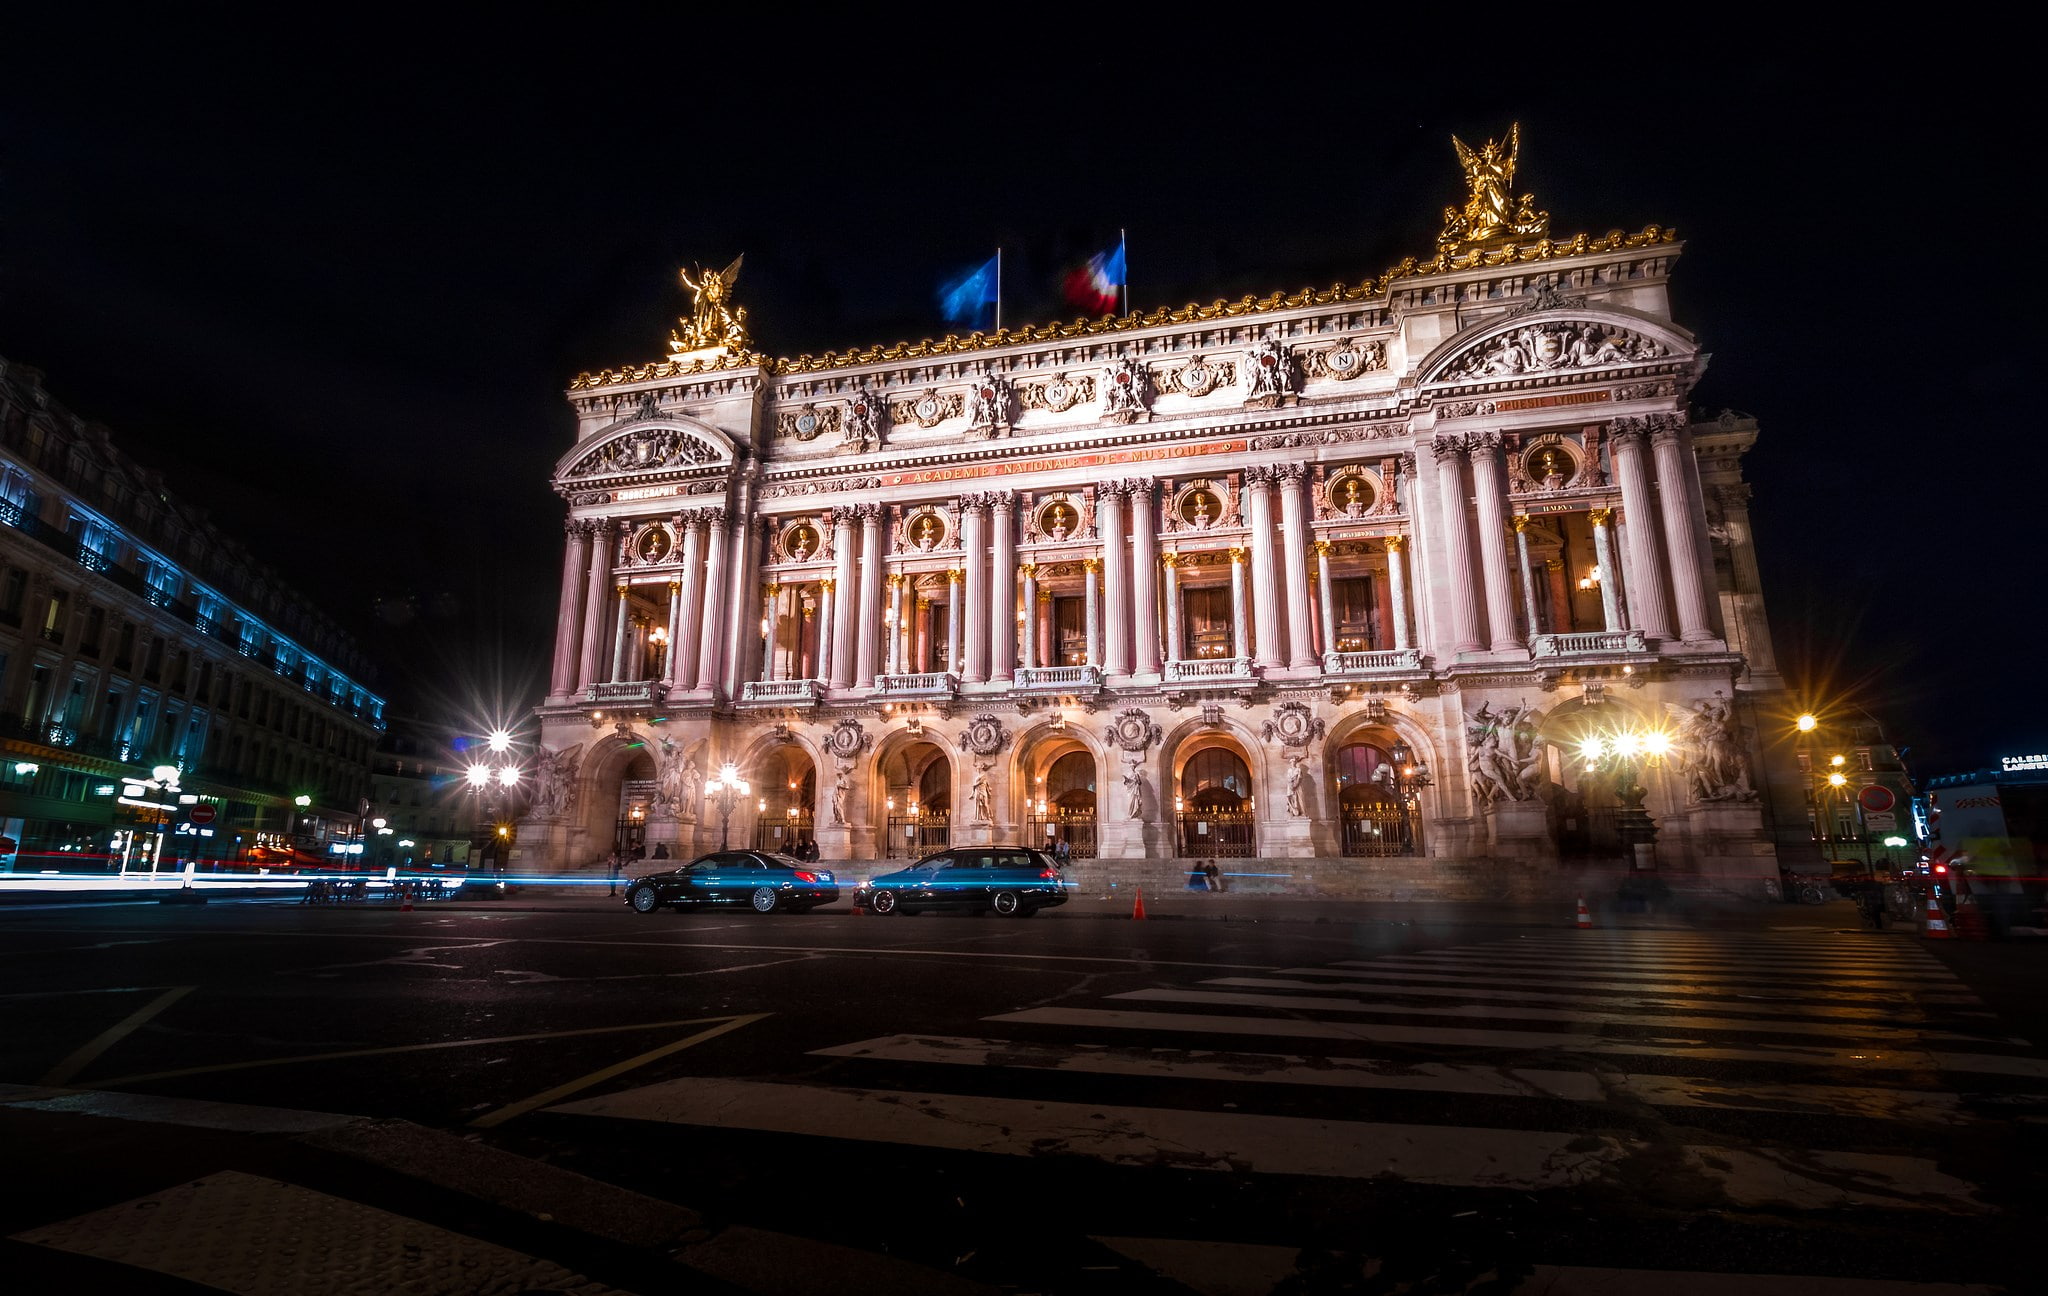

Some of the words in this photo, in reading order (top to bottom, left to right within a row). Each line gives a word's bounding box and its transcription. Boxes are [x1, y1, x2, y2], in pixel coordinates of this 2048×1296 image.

[1338, 355, 1348, 366] N
[1191, 372, 1200, 382] N
[1053, 388, 1062, 398] N
[924, 404, 932, 413] N
[803, 418, 811, 428] N
[914, 467, 990, 482] ACADEMIE
[1003, 458, 1079, 474] NATIONALE
[1095, 454, 1118, 464] DE
[1131, 444, 1208, 462] MUSIQUE
[2002, 754, 2048, 764] GALERI
